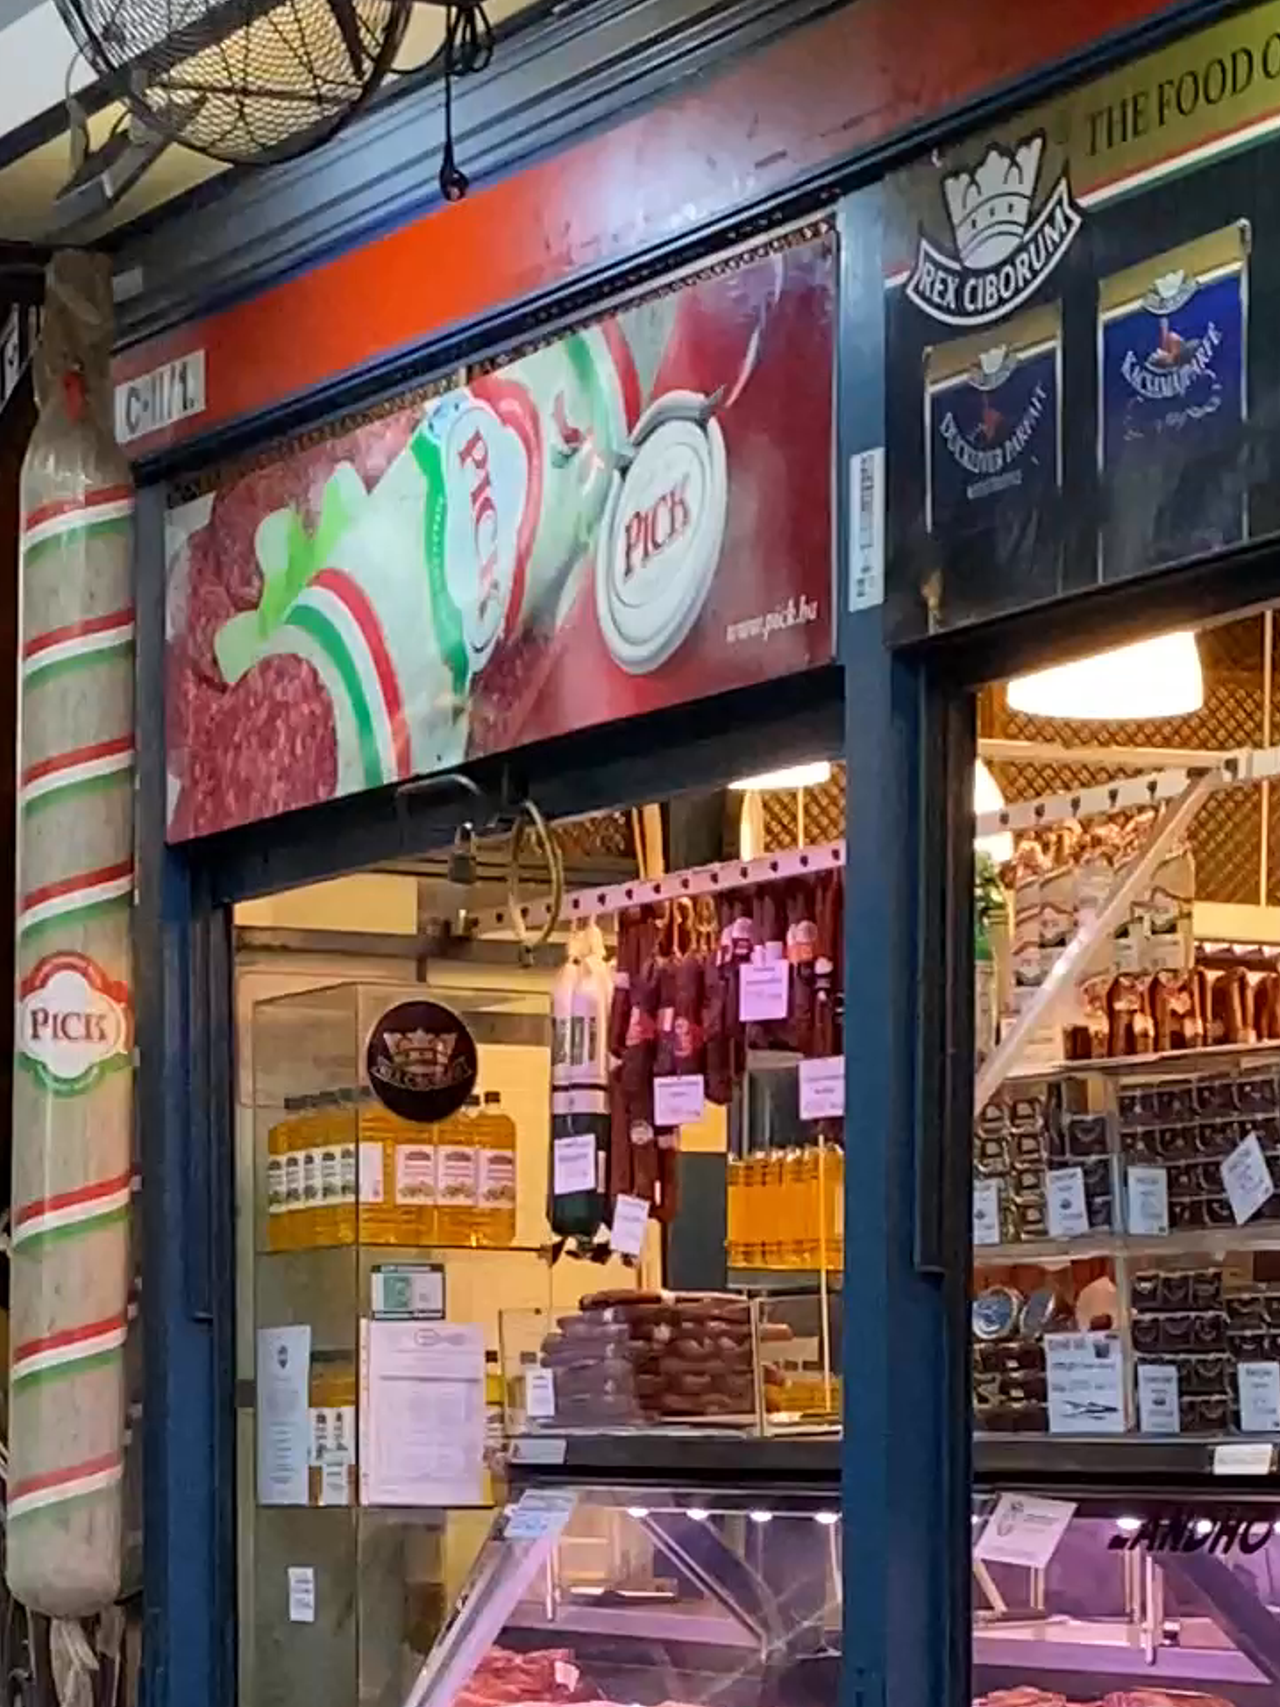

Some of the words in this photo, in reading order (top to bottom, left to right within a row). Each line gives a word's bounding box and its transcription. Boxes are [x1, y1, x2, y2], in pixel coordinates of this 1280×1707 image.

[1085, 90, 1150, 158] THE
[1157, 48, 1254, 124] FOOD
[920, 251, 960, 311] REX
[964, 211, 1069, 312] CIBORUM
[623, 475, 692, 577] PICK
[30, 1007, 108, 1041] PICK
